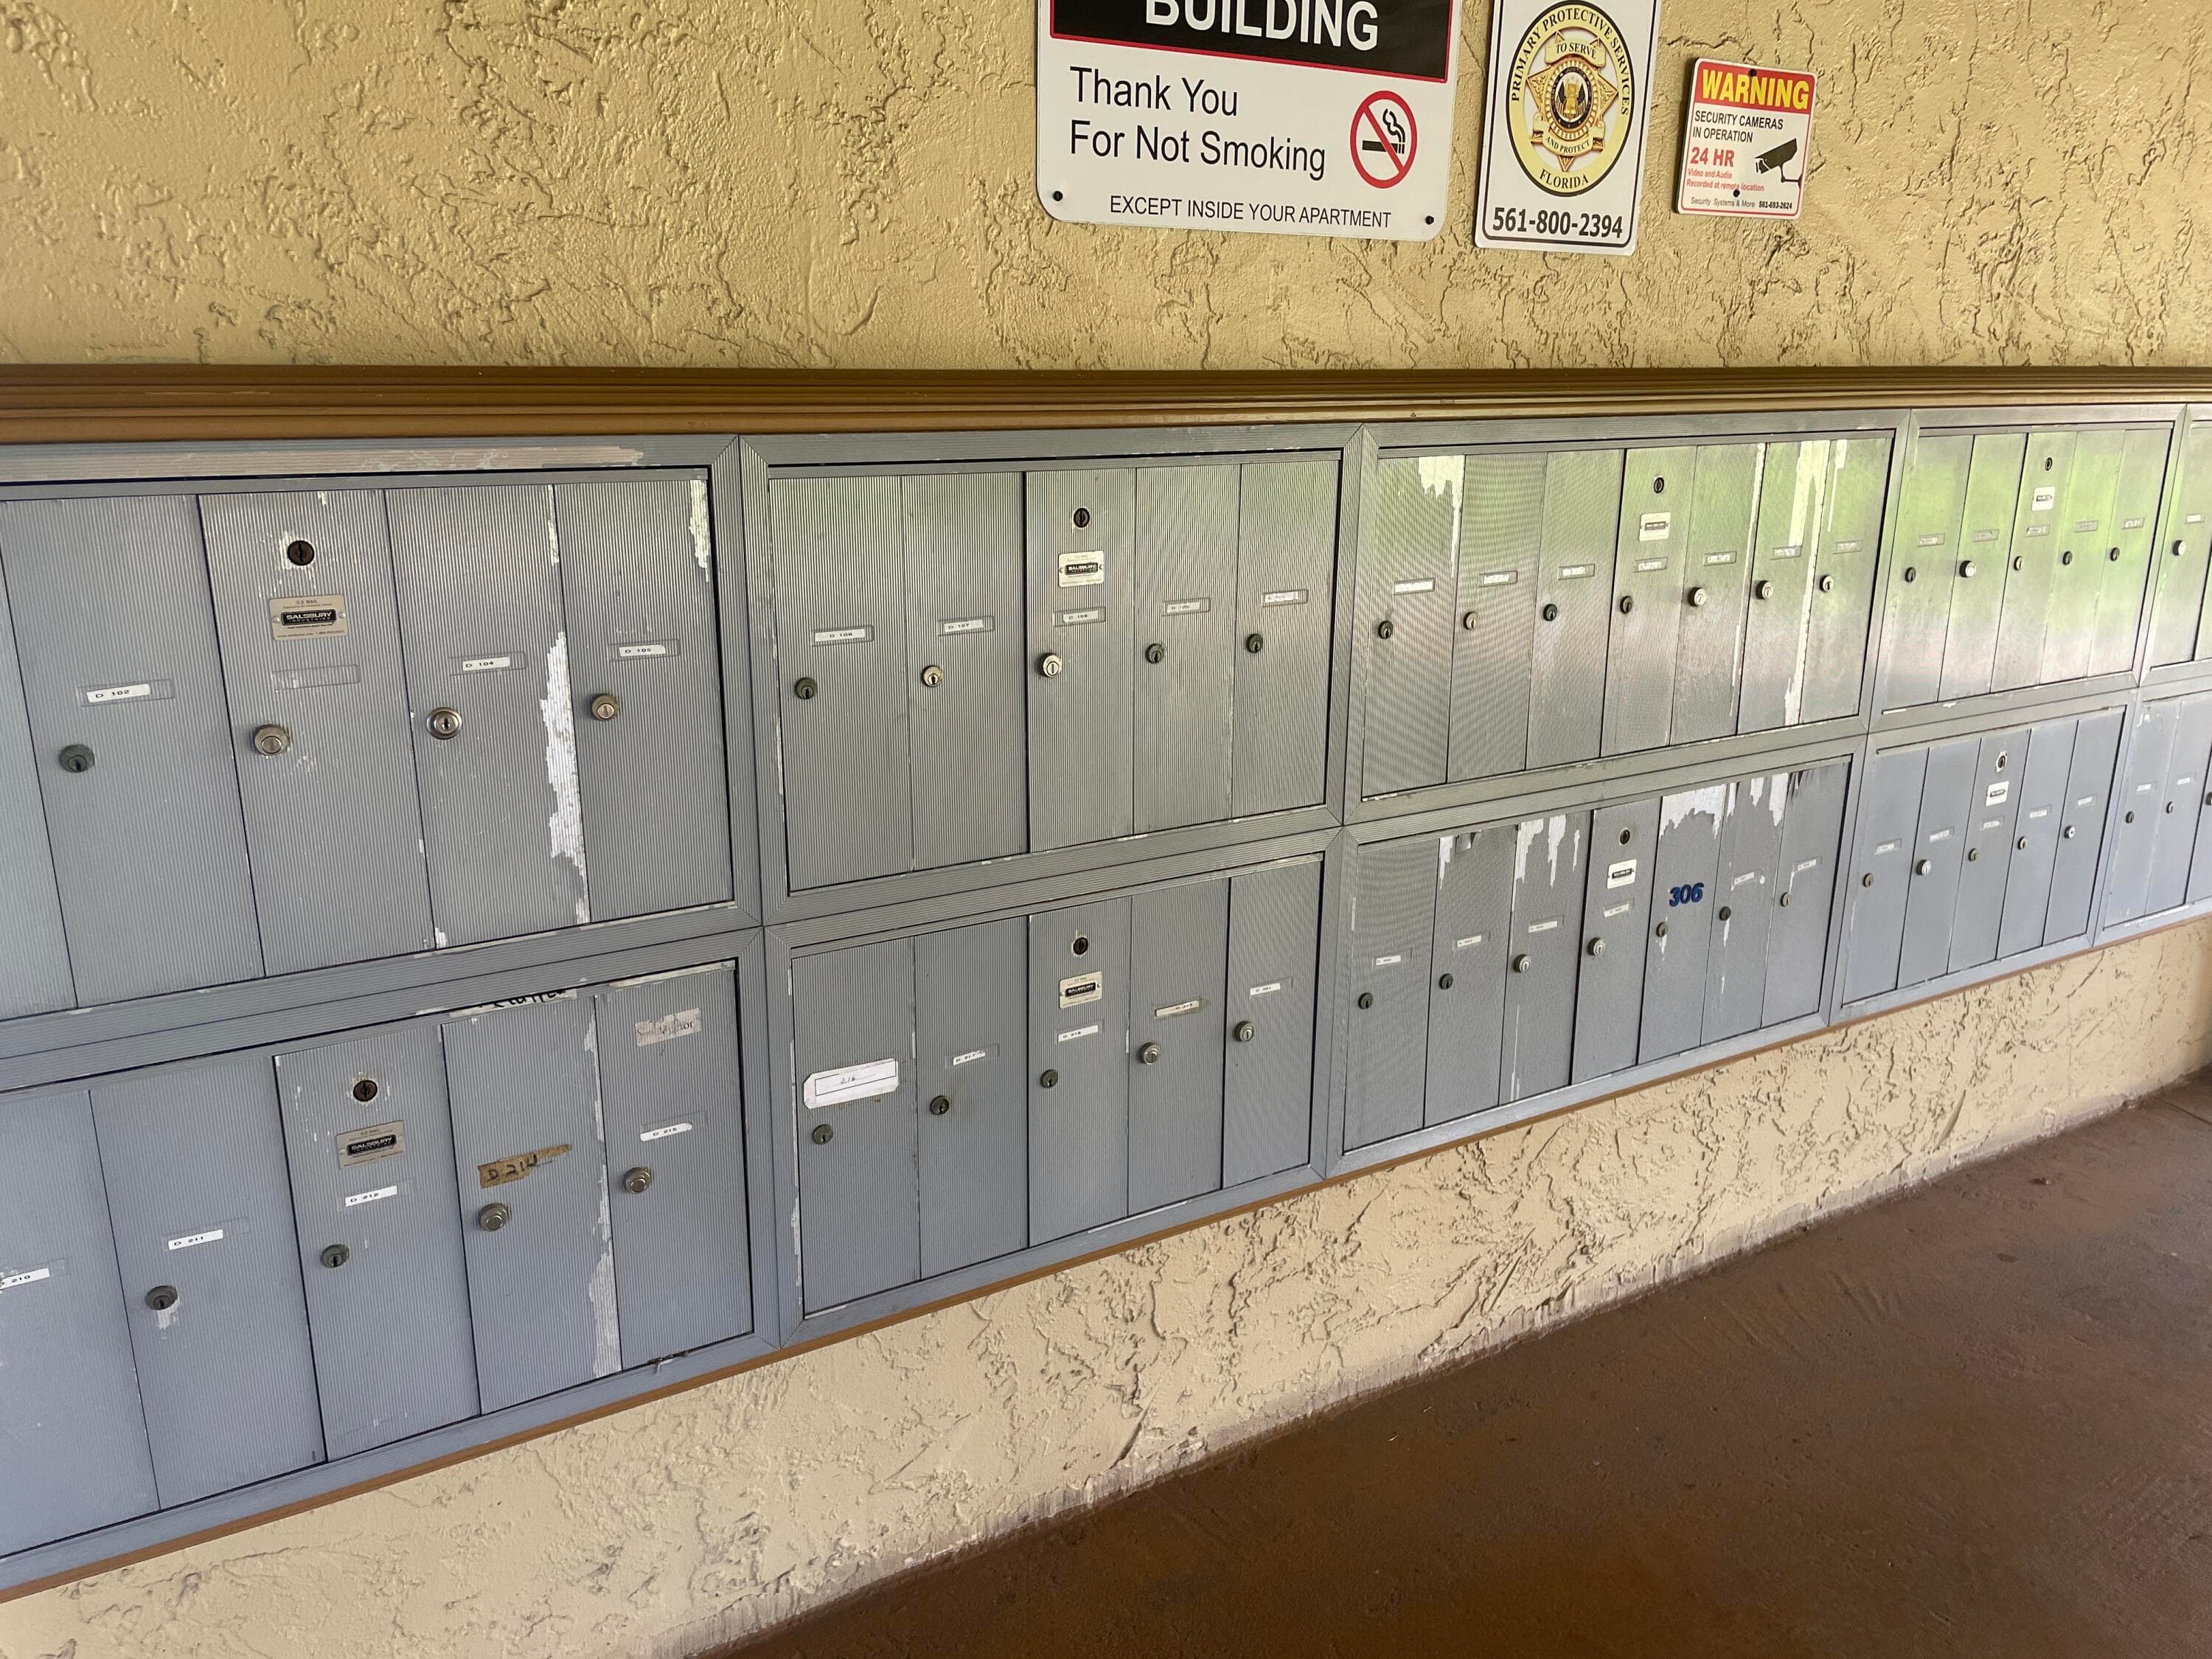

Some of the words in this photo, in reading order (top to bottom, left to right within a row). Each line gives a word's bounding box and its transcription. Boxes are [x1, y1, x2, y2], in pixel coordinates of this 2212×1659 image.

[1146, 0, 1379, 51] BUILDING
[1556, 42, 1568, 54] TO
[1568, 42, 1597, 60] SERVE
[1512, 27, 1542, 102] PRIMARY
[1542, 7, 1611, 40] PROTECTIVE
[1610, 39, 1629, 116] SERVICES
[1069, 66, 1172, 111] Thank
[1181, 77, 1239, 116] You
[1703, 69, 1809, 110] WARNING
[1694, 110, 1738, 126] SECURITY
[1739, 115, 1784, 130] CAMERAS
[1692, 126, 1702, 138] IN
[1703, 128, 1753, 143] OPERATION
[1071, 119, 1125, 158] For
[1136, 125, 1190, 164] Not
[1200, 130, 1326, 181] Smoking
[1545, 137, 1559, 150] AND
[1559, 139, 1590, 153] PROTECT
[1690, 147, 1708, 165] 24
[1713, 149, 1735, 167] HR
[1539, 168, 1589, 189] FLORIDA
[1688, 168, 1703, 178] Video
[1704, 170, 1716, 178] and
[1716, 170, 1733, 179] Audio
[1686, 179, 1713, 189] Recorded
[1714, 181, 1719, 189] at
[1720, 181, 1740, 190] remote
[1741, 181, 1764, 192] location
[1110, 195, 1183, 216] EXCEPT
[1187, 199, 1244, 220] INSIDE
[1248, 203, 1296, 223] YOUR
[1300, 206, 1392, 229] APARTMENT
[1691, 197, 1711, 207] Security
[1714, 198, 1734, 207] Systems
[1736, 199, 1741, 207] &
[1742, 200, 1756, 208] More
[1492, 206, 1623, 238] 561-800-2394
[286, 611, 332, 620] SALSBURY
[1669, 882, 1705, 907] 306
[840, 1075, 856, 1085] 216
[352, 1137, 392, 1150] SALSBURY
[486, 1168, 498, 1183] D
[505, 1153, 538, 1178] 214
[12, 1275, 30, 1283] 210
